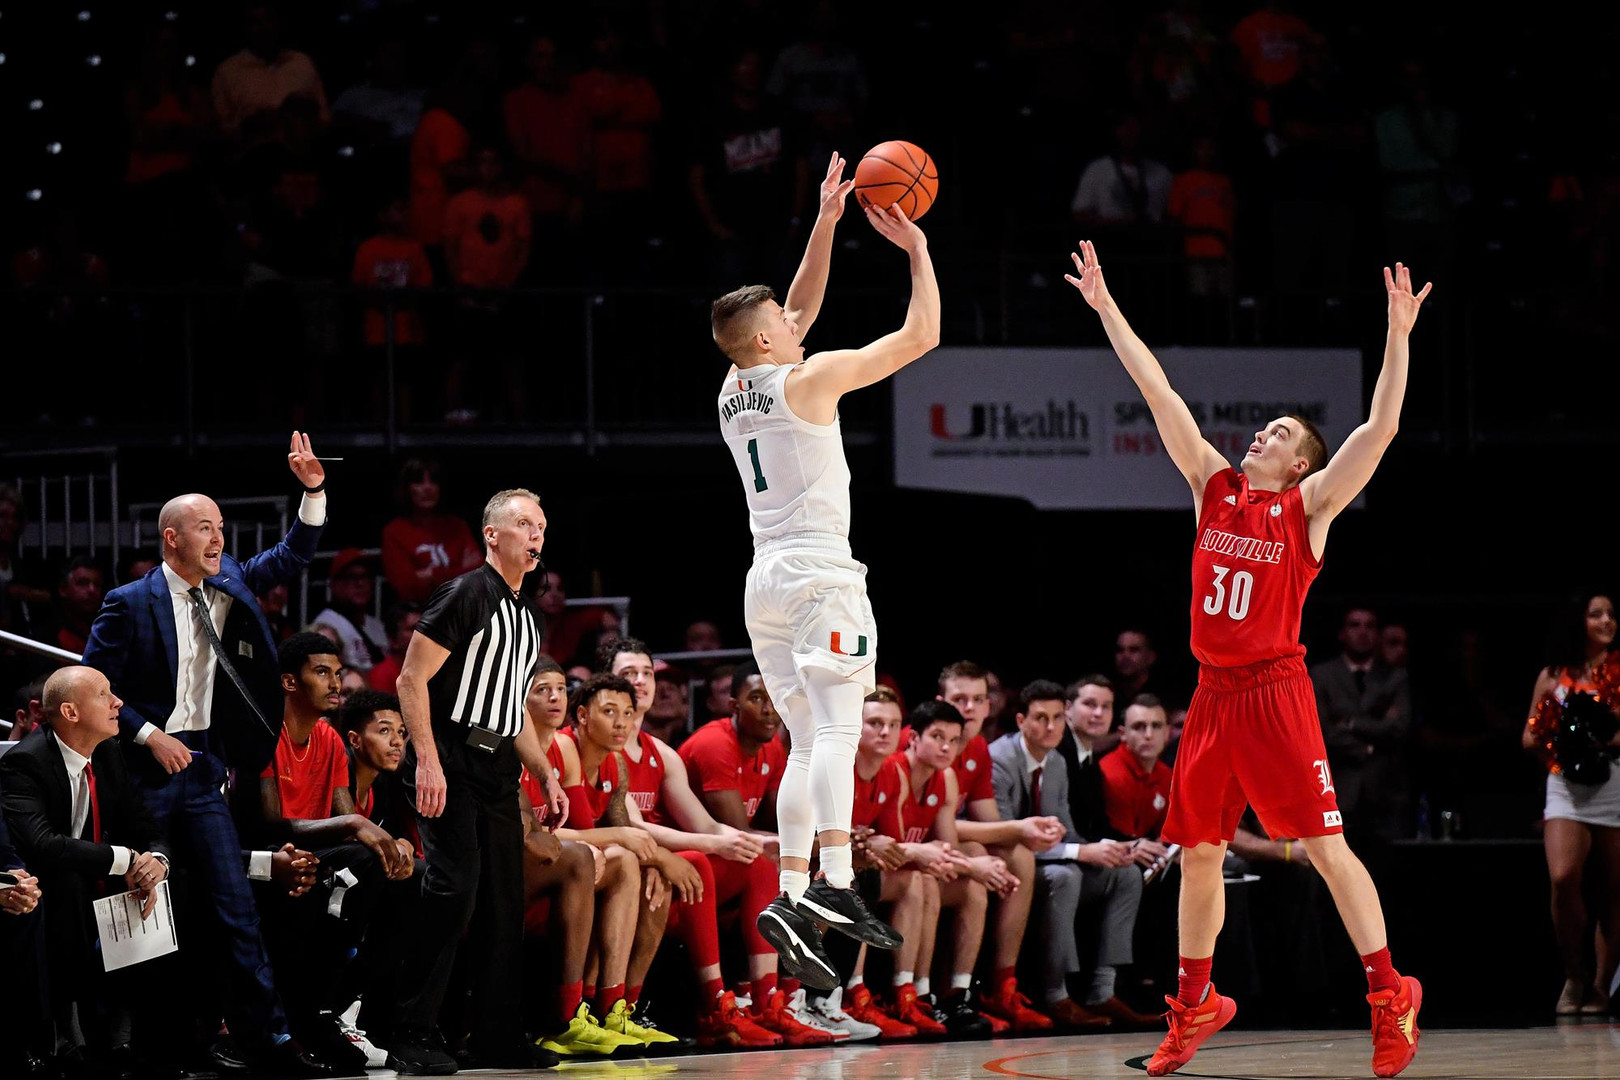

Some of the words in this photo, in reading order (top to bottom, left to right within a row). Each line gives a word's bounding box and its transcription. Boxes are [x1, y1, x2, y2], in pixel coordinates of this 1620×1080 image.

[738, 380, 753, 392] U
[721, 392, 774, 423] VASILJEVIC
[1114, 402, 1207, 426] SPS
[747, 438, 768, 493] 1
[1199, 528, 1285, 564] LOUISVILLE
[1203, 564, 1254, 620] 30
[830, 631, 867, 657] U
